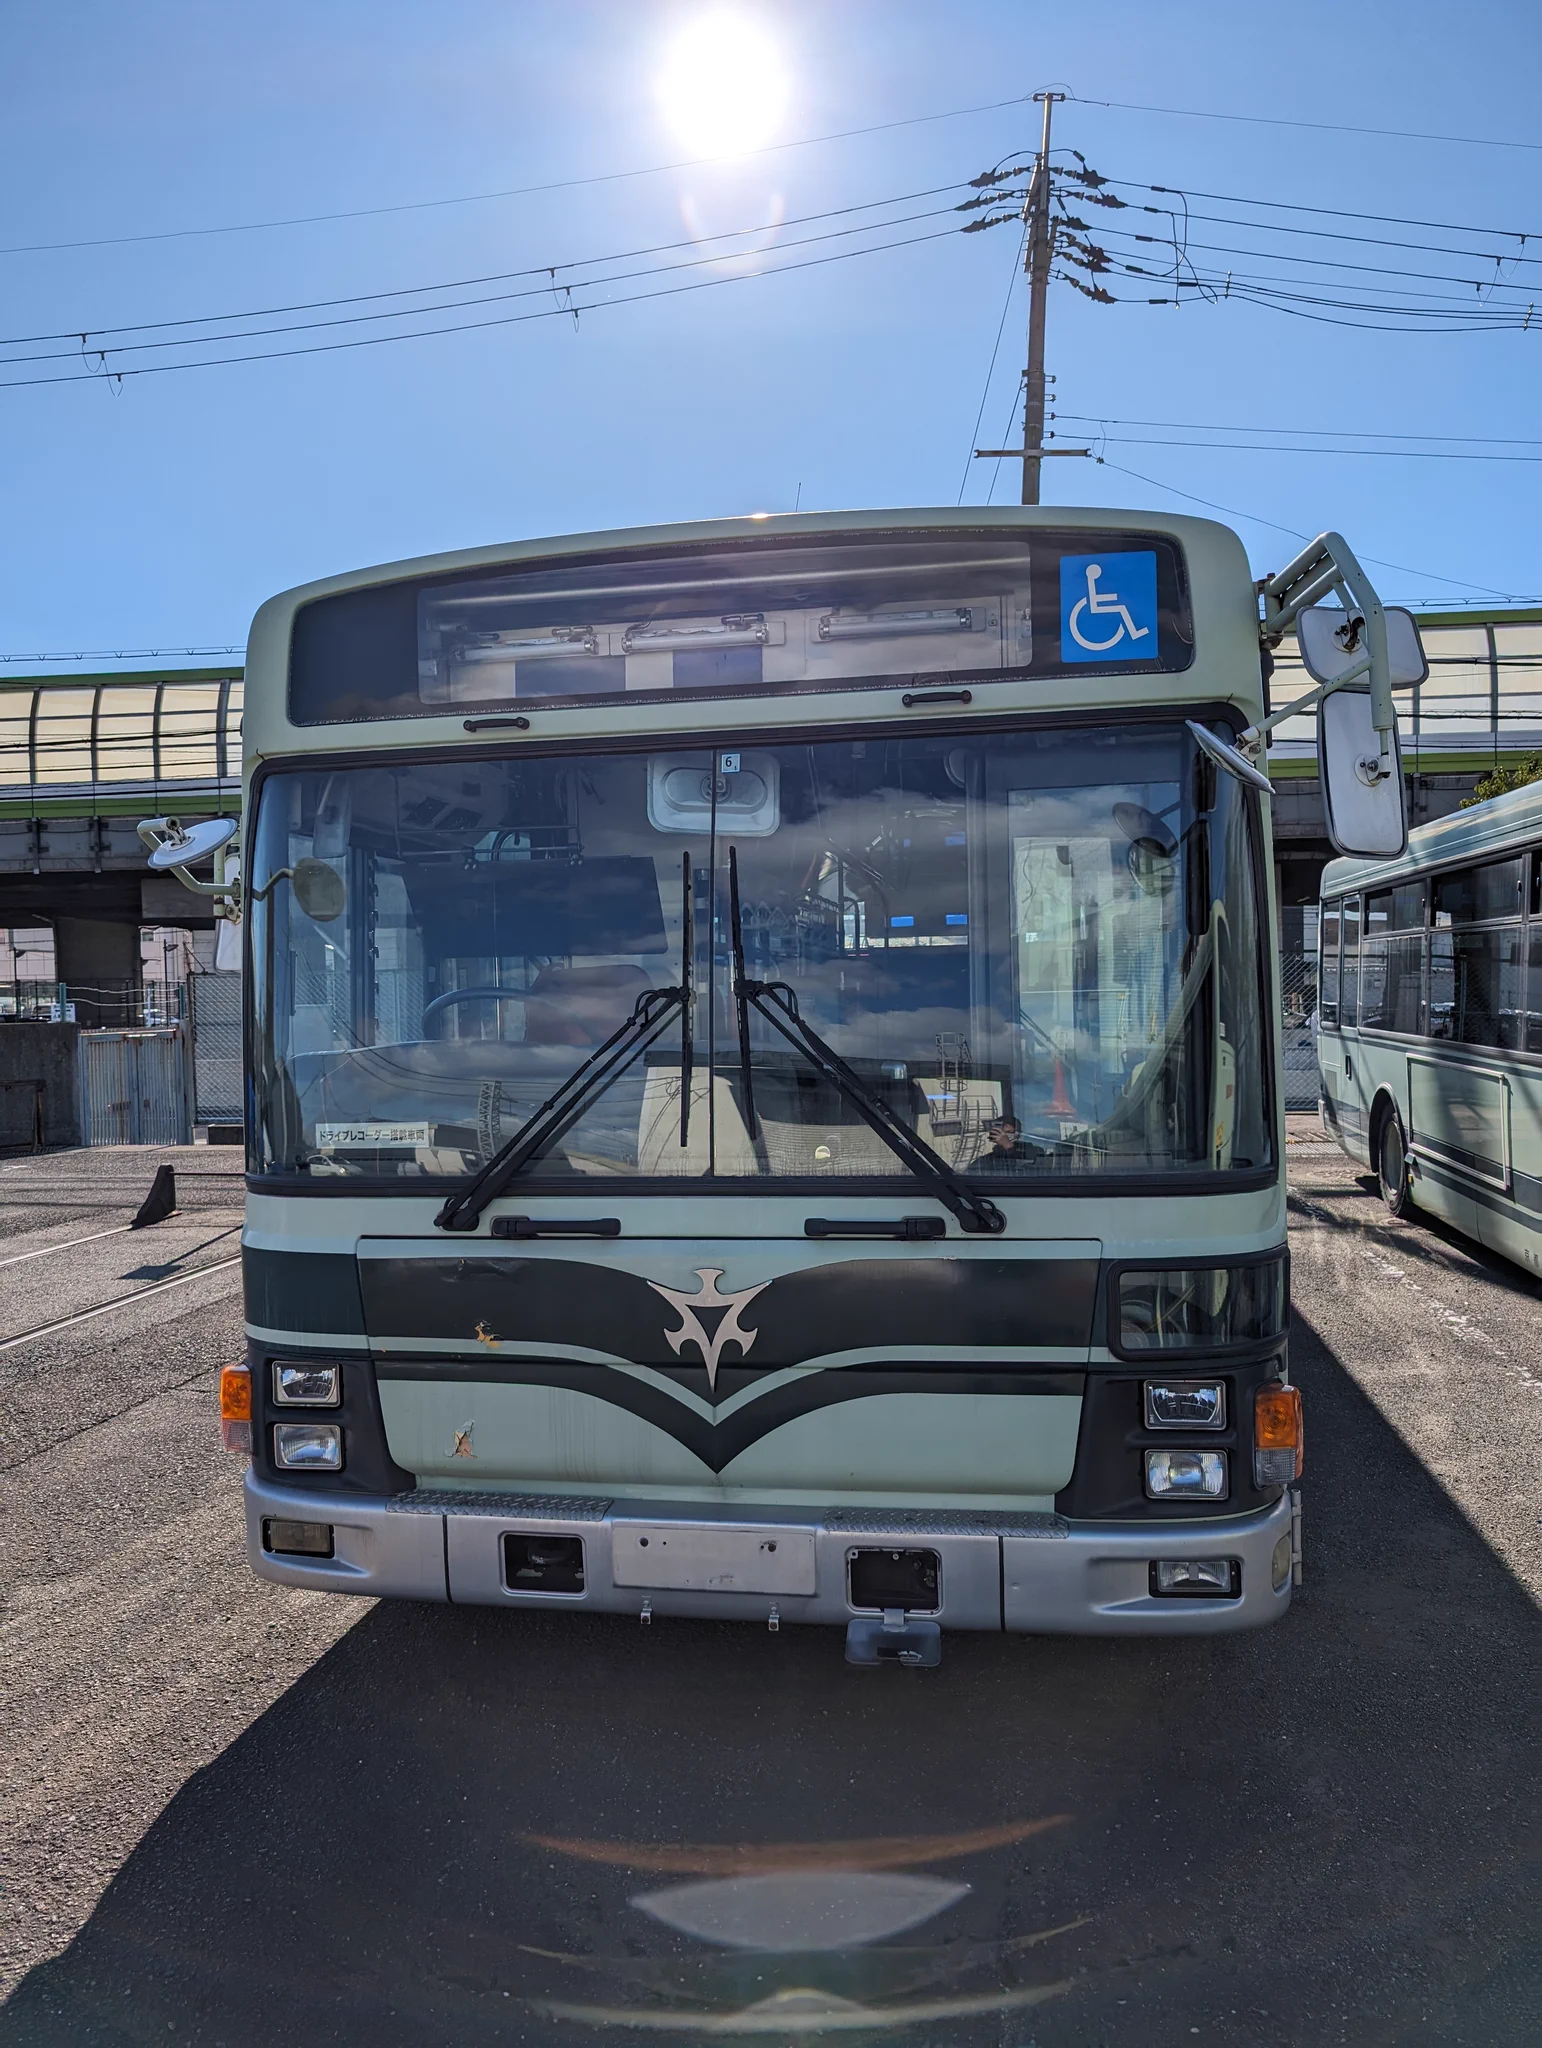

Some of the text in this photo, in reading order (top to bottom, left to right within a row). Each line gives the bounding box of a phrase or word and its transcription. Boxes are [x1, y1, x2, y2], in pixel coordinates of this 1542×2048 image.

[725, 756, 732, 767] 6
[320, 1129, 425, 1141] ドライブレコーダー搭載車両
